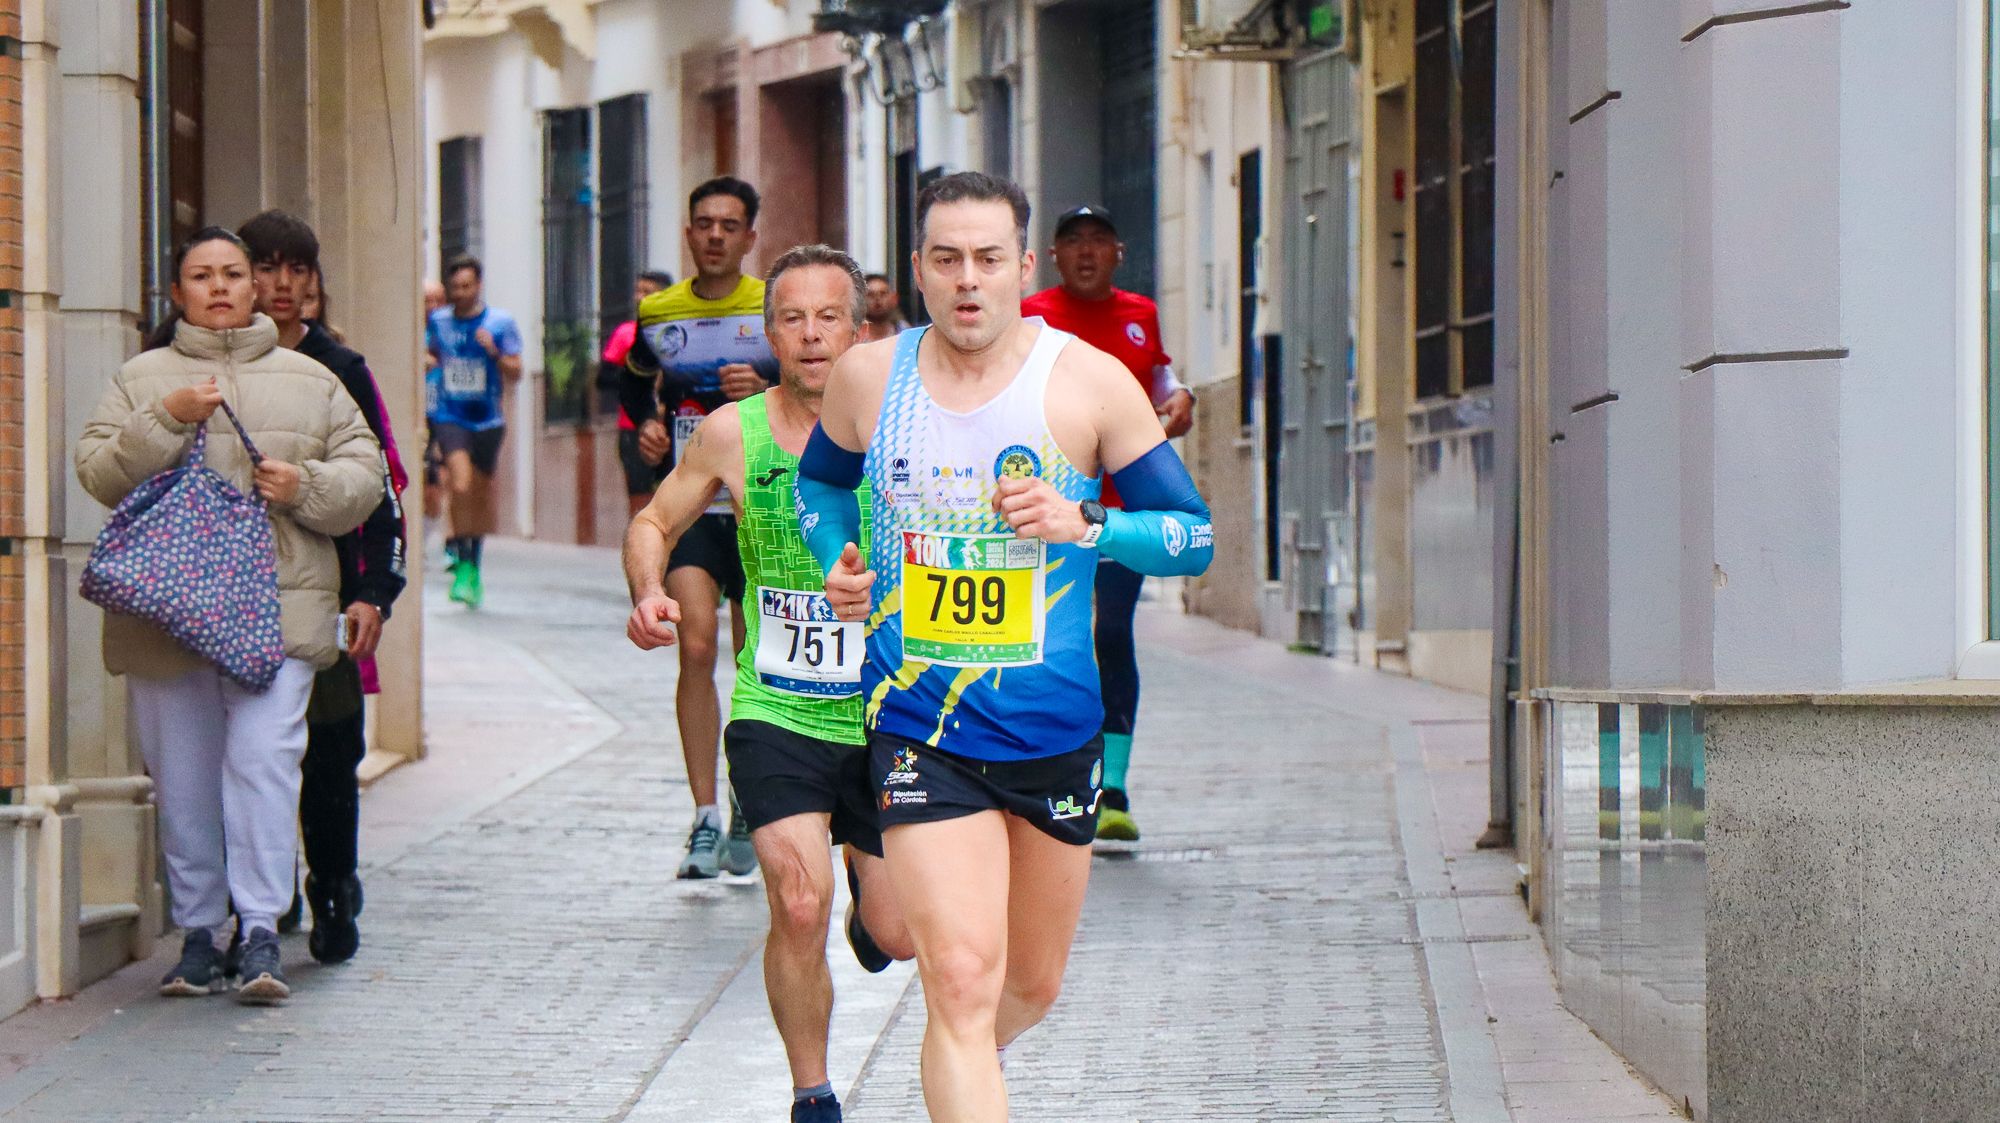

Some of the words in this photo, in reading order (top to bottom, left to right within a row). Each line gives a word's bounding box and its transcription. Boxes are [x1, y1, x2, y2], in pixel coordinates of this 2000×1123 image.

[932, 466, 973, 479] DOWN
[911, 534, 950, 569] 10K
[774, 592, 810, 621] 21K
[927, 573, 1005, 626] 799
[784, 623, 845, 667] 751
[892, 790, 928, 799] Diputación
